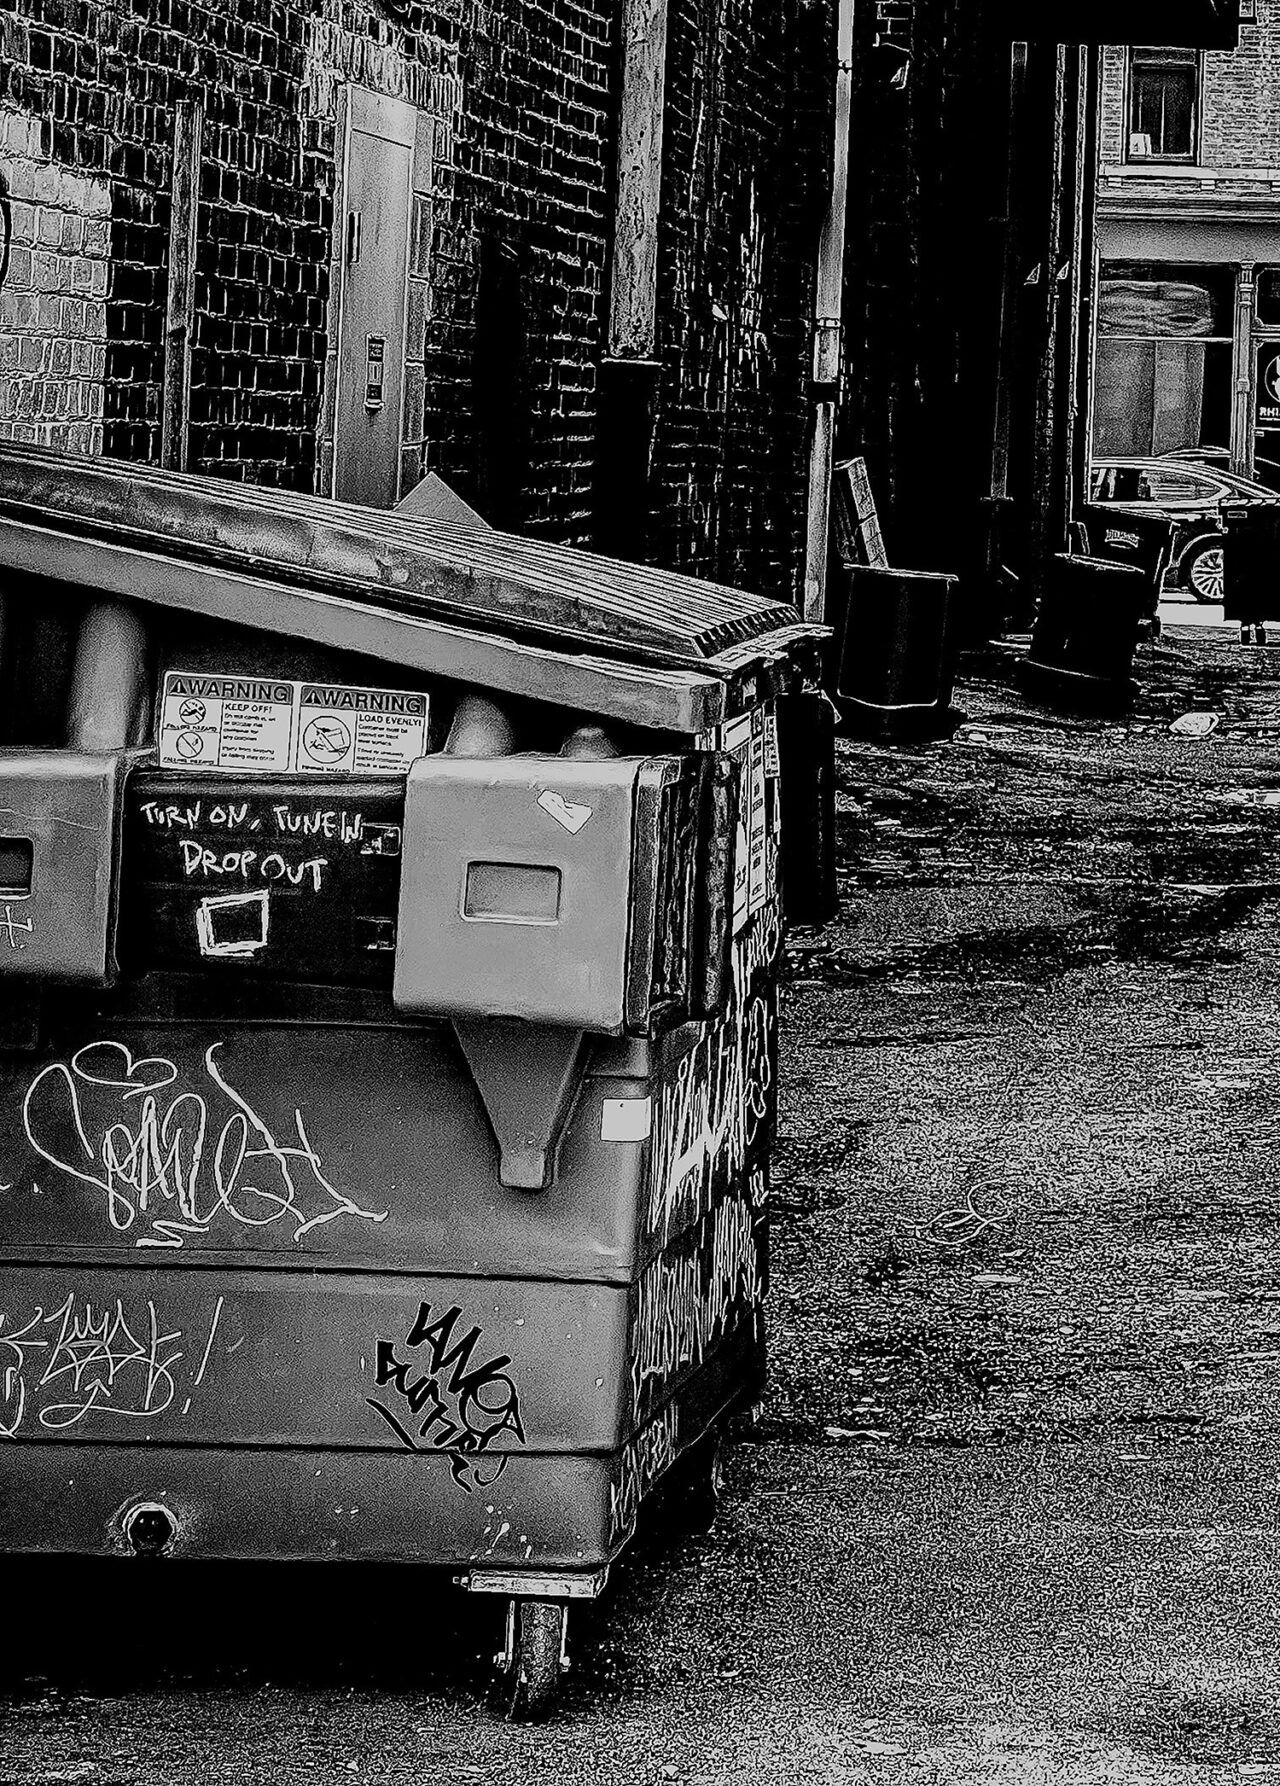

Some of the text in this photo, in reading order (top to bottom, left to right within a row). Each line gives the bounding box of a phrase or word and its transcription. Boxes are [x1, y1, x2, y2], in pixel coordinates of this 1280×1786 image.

[188, 679, 289, 702] WARNING
[322, 689, 422, 713] WARNING
[224, 703, 250, 712] KEEP
[359, 714, 383, 724] LOAD
[140, 801, 201, 829] TURN
[273, 805, 337, 837] TUNE
[179, 840, 328, 892] DROP OUT
